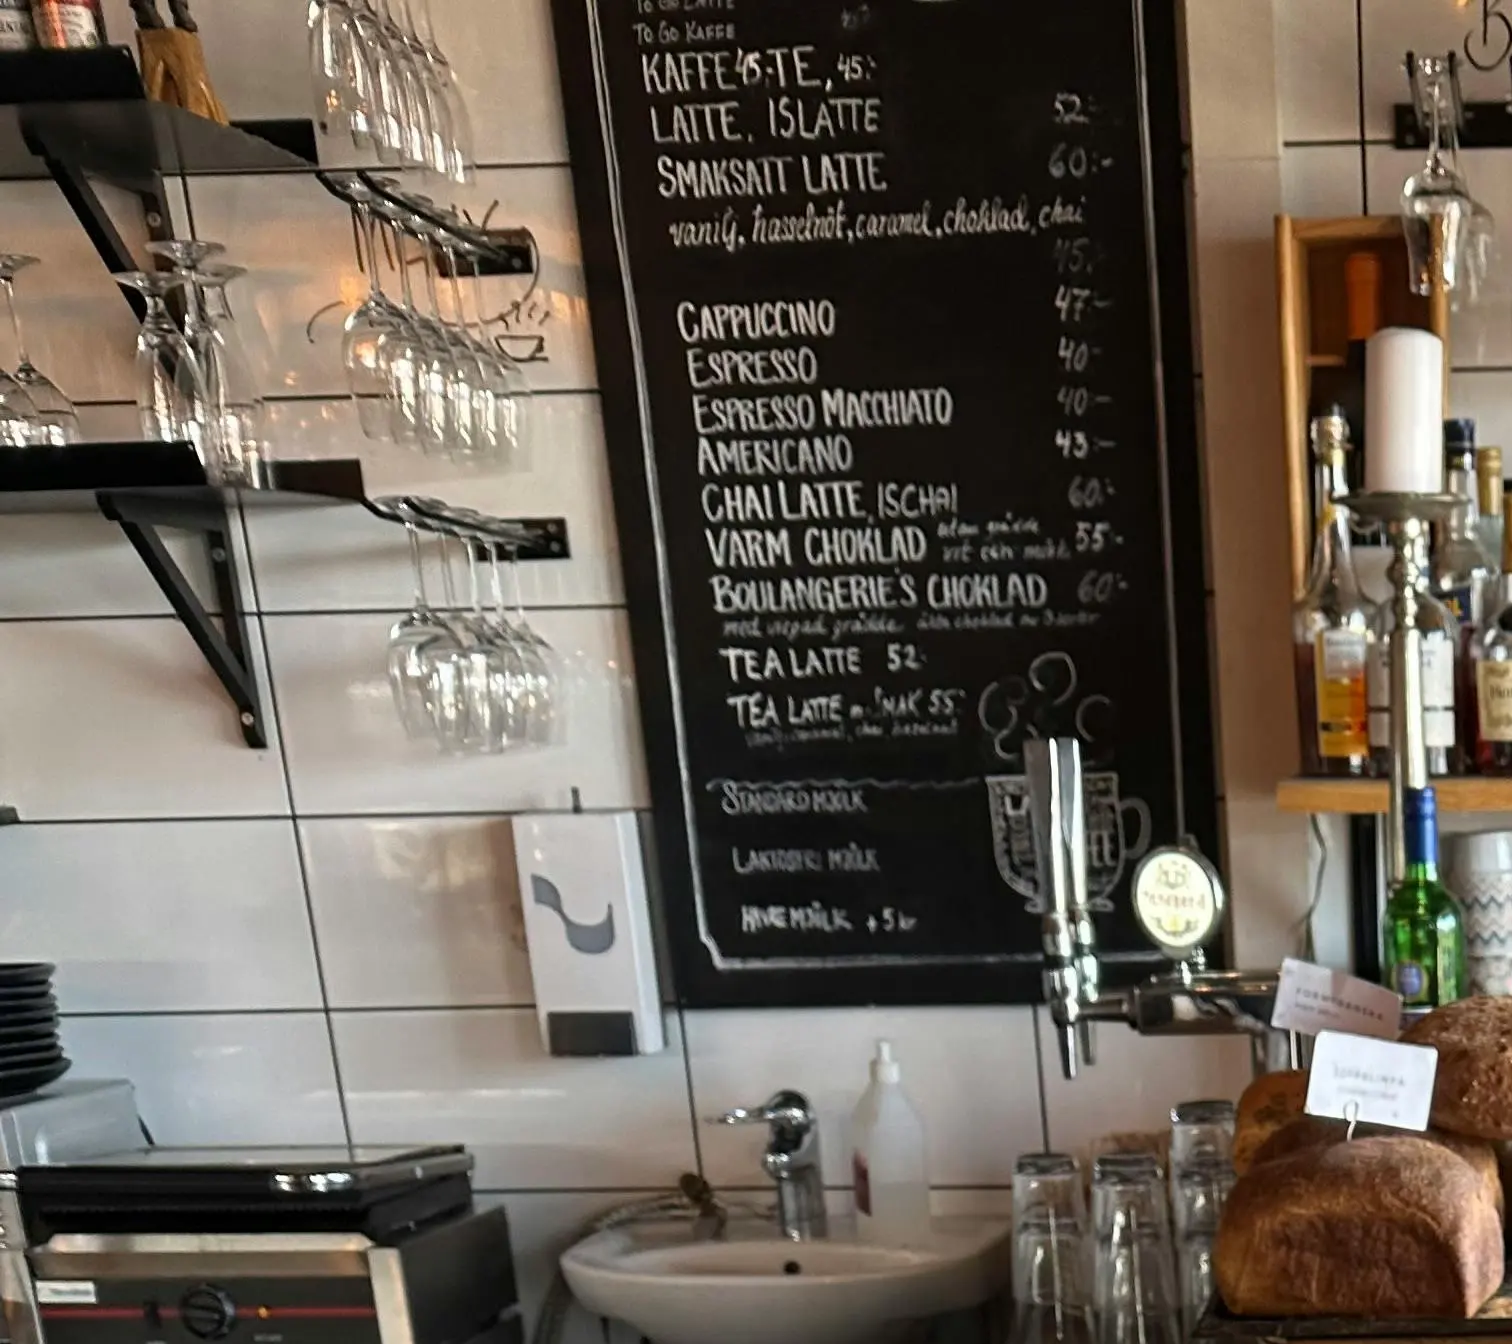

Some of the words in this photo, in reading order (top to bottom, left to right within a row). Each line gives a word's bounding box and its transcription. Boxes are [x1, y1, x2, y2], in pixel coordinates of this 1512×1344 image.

[641, 51, 738, 93] KAFFE
[657, 154, 793, 198] SMAKSATT
[704, 527, 793, 568] VARM
[803, 525, 928, 567] CHOKLAD
[926, 571, 1048, 610] CHOKLAD
[788, 646, 863, 678] LATTE
[726, 691, 782, 729] TEA
[787, 694, 843, 725] LATTE
